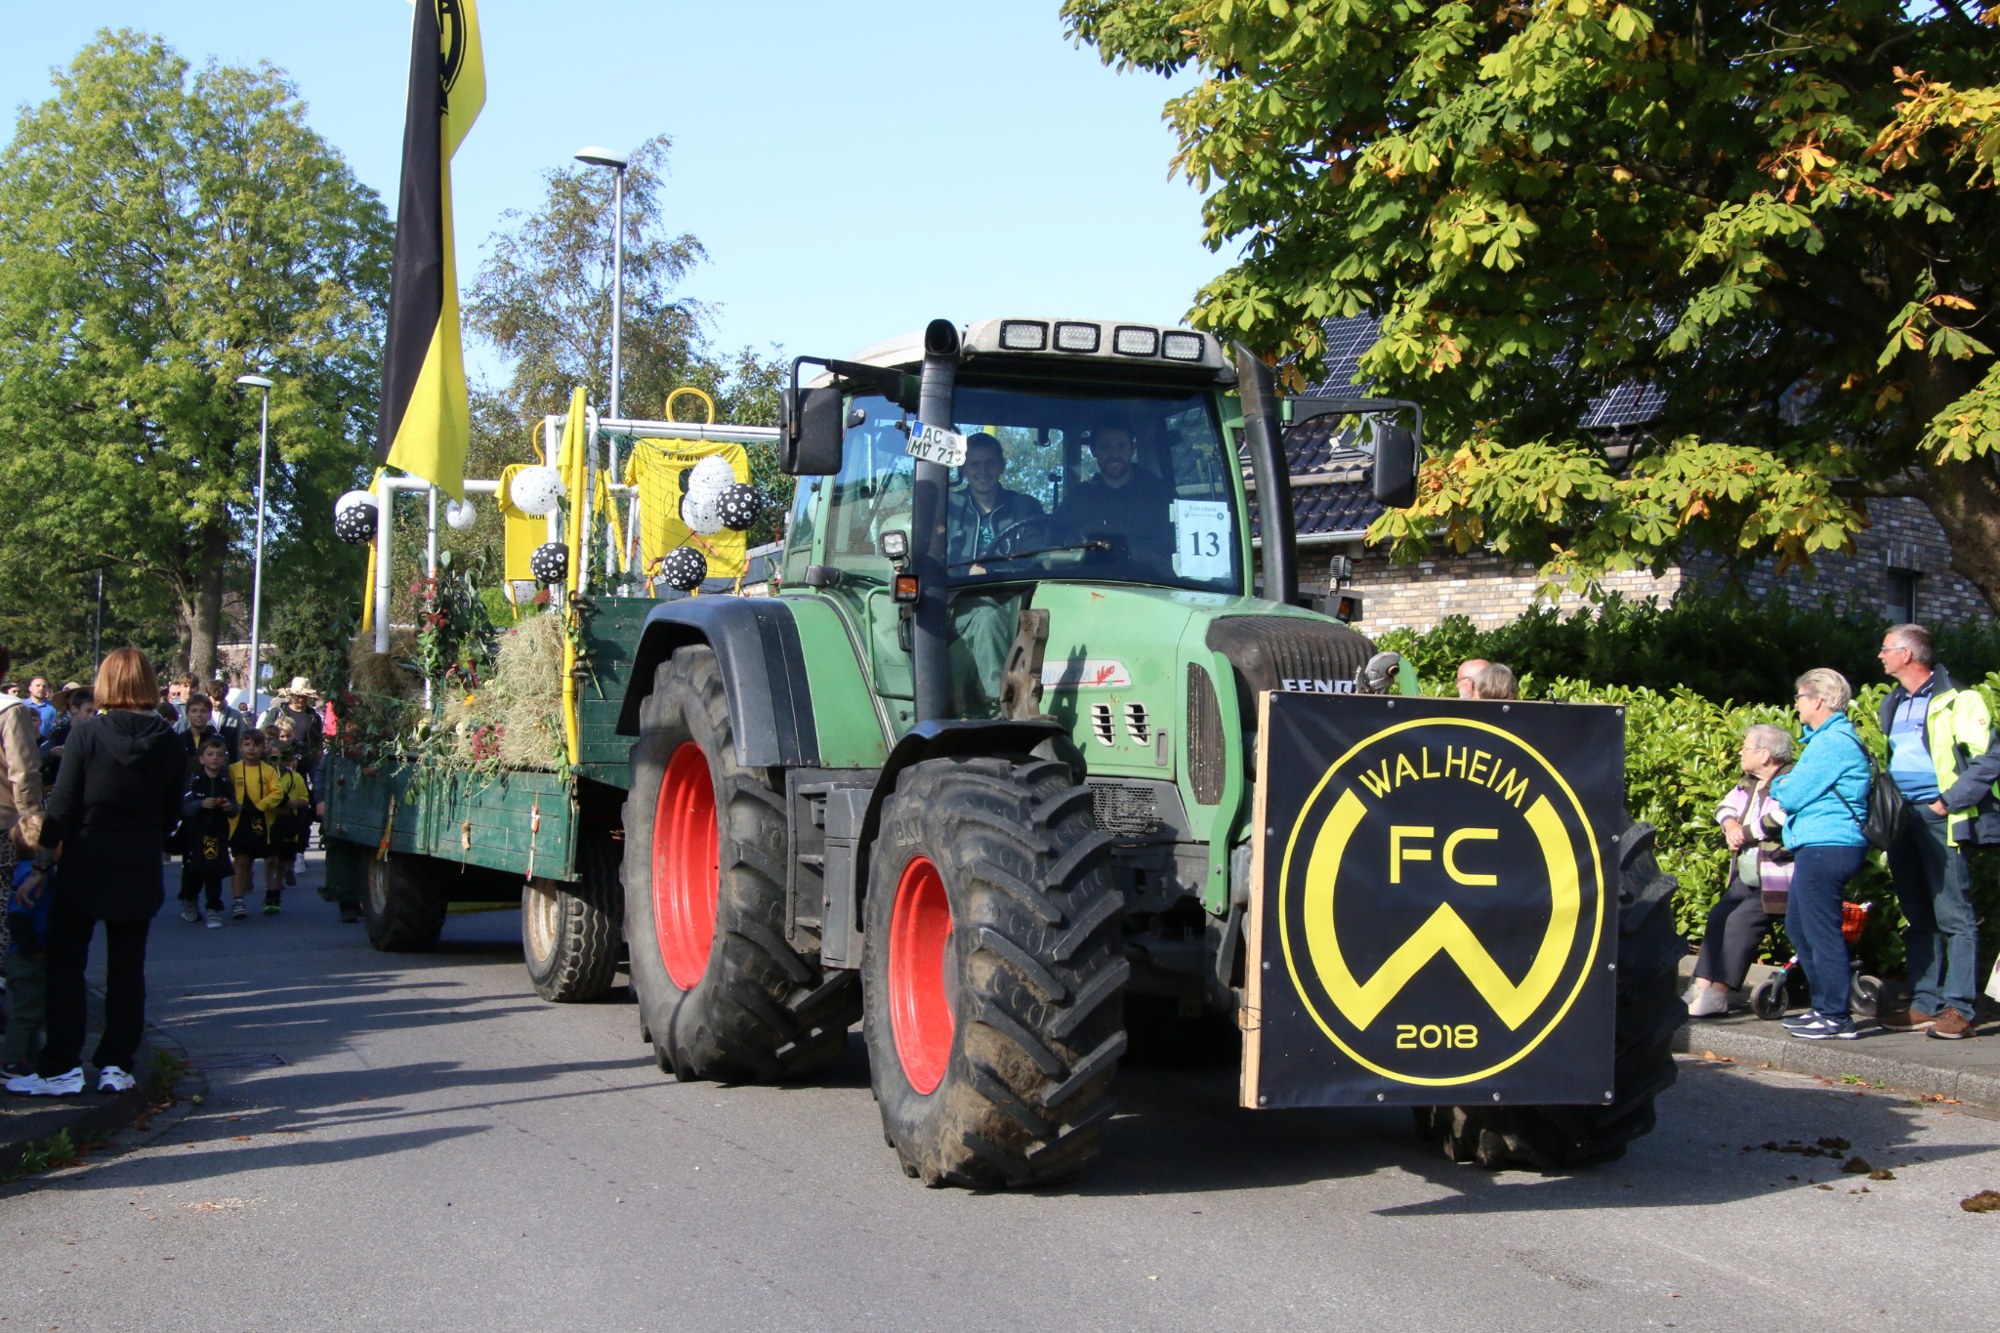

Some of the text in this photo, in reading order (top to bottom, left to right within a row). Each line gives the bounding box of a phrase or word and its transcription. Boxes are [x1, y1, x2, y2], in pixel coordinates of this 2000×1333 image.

[923, 427, 943, 444] AC
[910, 440, 932, 457] MV
[1189, 531, 1220, 557] 13
[1282, 679, 1354, 695] FEND
[1358, 745, 1529, 808] WALHEIM
[1390, 825, 1499, 886] FC
[1396, 1025, 1478, 1049] 2018
